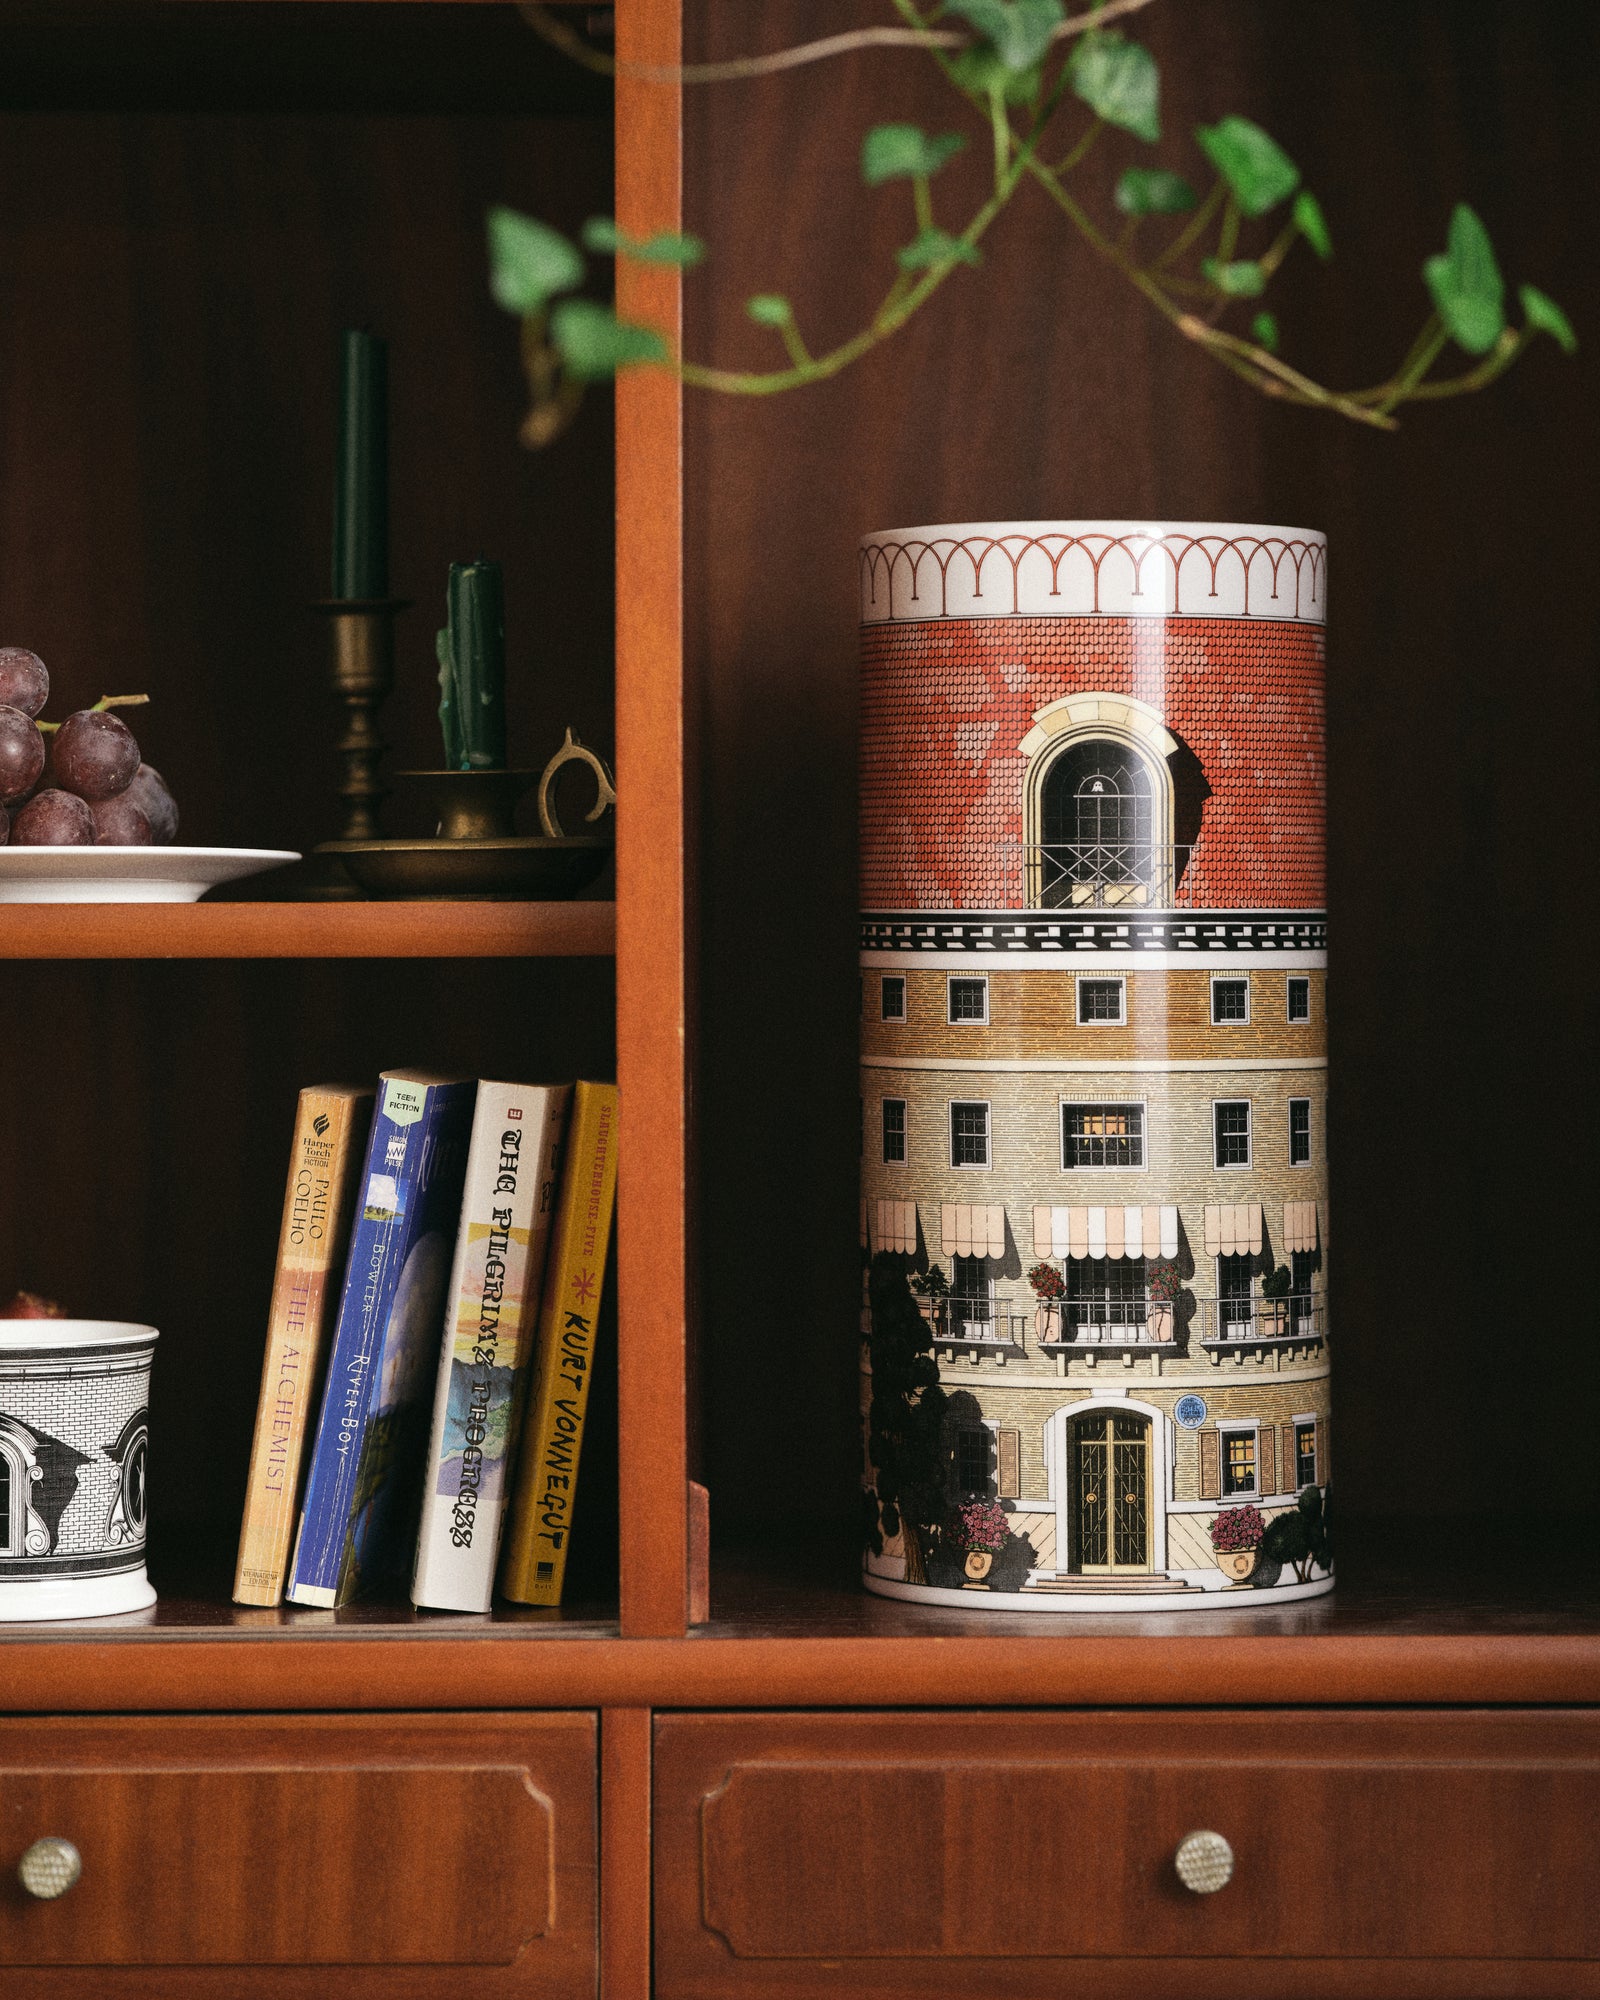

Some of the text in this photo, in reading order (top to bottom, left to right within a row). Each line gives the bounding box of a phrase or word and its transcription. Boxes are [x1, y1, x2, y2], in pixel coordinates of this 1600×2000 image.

[389, 1101, 420, 1112] FICTION
[396, 1092, 417, 1103] TEEN
[303, 1137, 335, 1150] Harper
[304, 1158, 329, 1168] FICTION
[305, 1147, 331, 1158] Torch
[493, 1129, 522, 1195] THE
[290, 1169, 312, 1245] COELHO
[309, 1178, 330, 1239] PAULO
[583, 1106, 612, 1257] SLAUGHTERHOUSE-FIVE
[361, 1244, 385, 1312] BOWLER
[265, 1287, 309, 1495] THE ALCHEMIST
[537, 1311, 591, 1549] KURT VONNEGUT
[449, 1379, 493, 1549] PROGRESS
